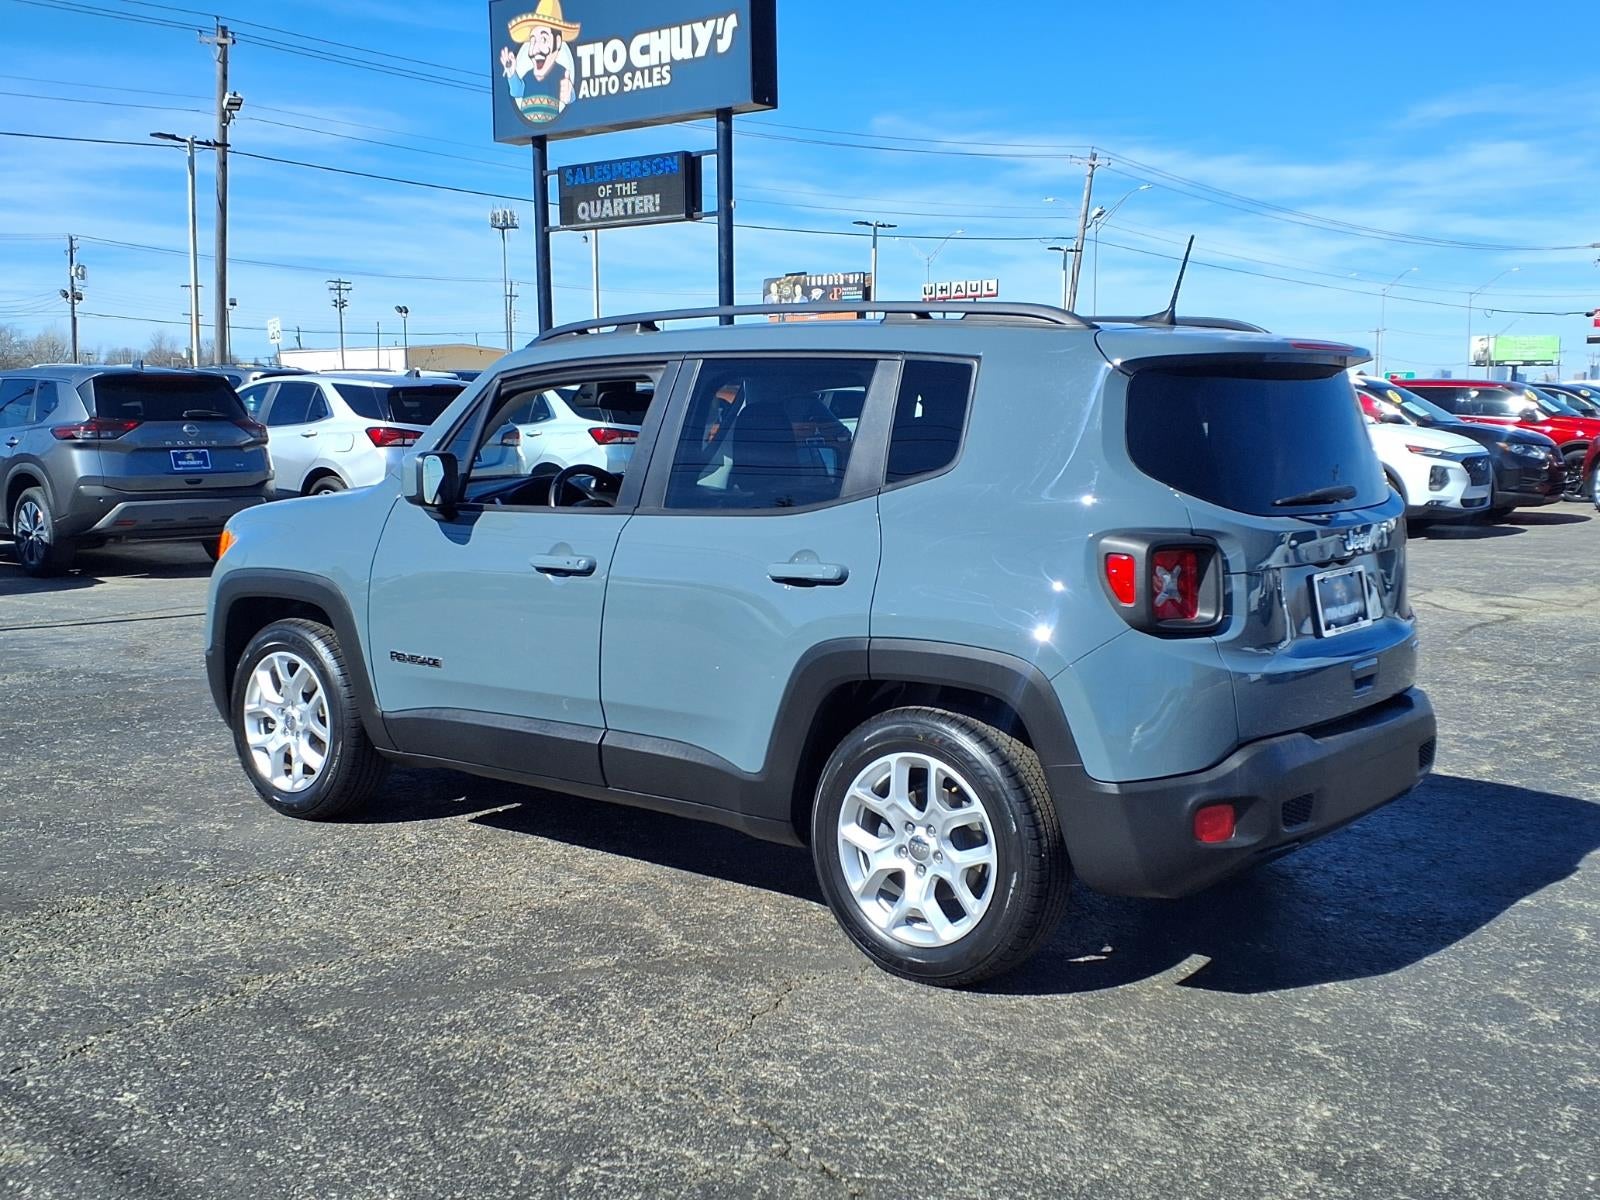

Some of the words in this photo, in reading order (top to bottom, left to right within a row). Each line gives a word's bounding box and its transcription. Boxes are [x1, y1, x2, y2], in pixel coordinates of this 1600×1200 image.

[577, 38, 627, 78] TIO
[629, 13, 738, 68] CHUY'S
[578, 75, 620, 99] AUTO
[623, 65, 672, 92] SALES
[564, 156, 679, 186] SALESPERSON
[598, 184, 613, 198] OF
[615, 181, 638, 196] THE
[577, 193, 660, 220] QUARTER!
[389, 650, 442, 668] RENEGADE
